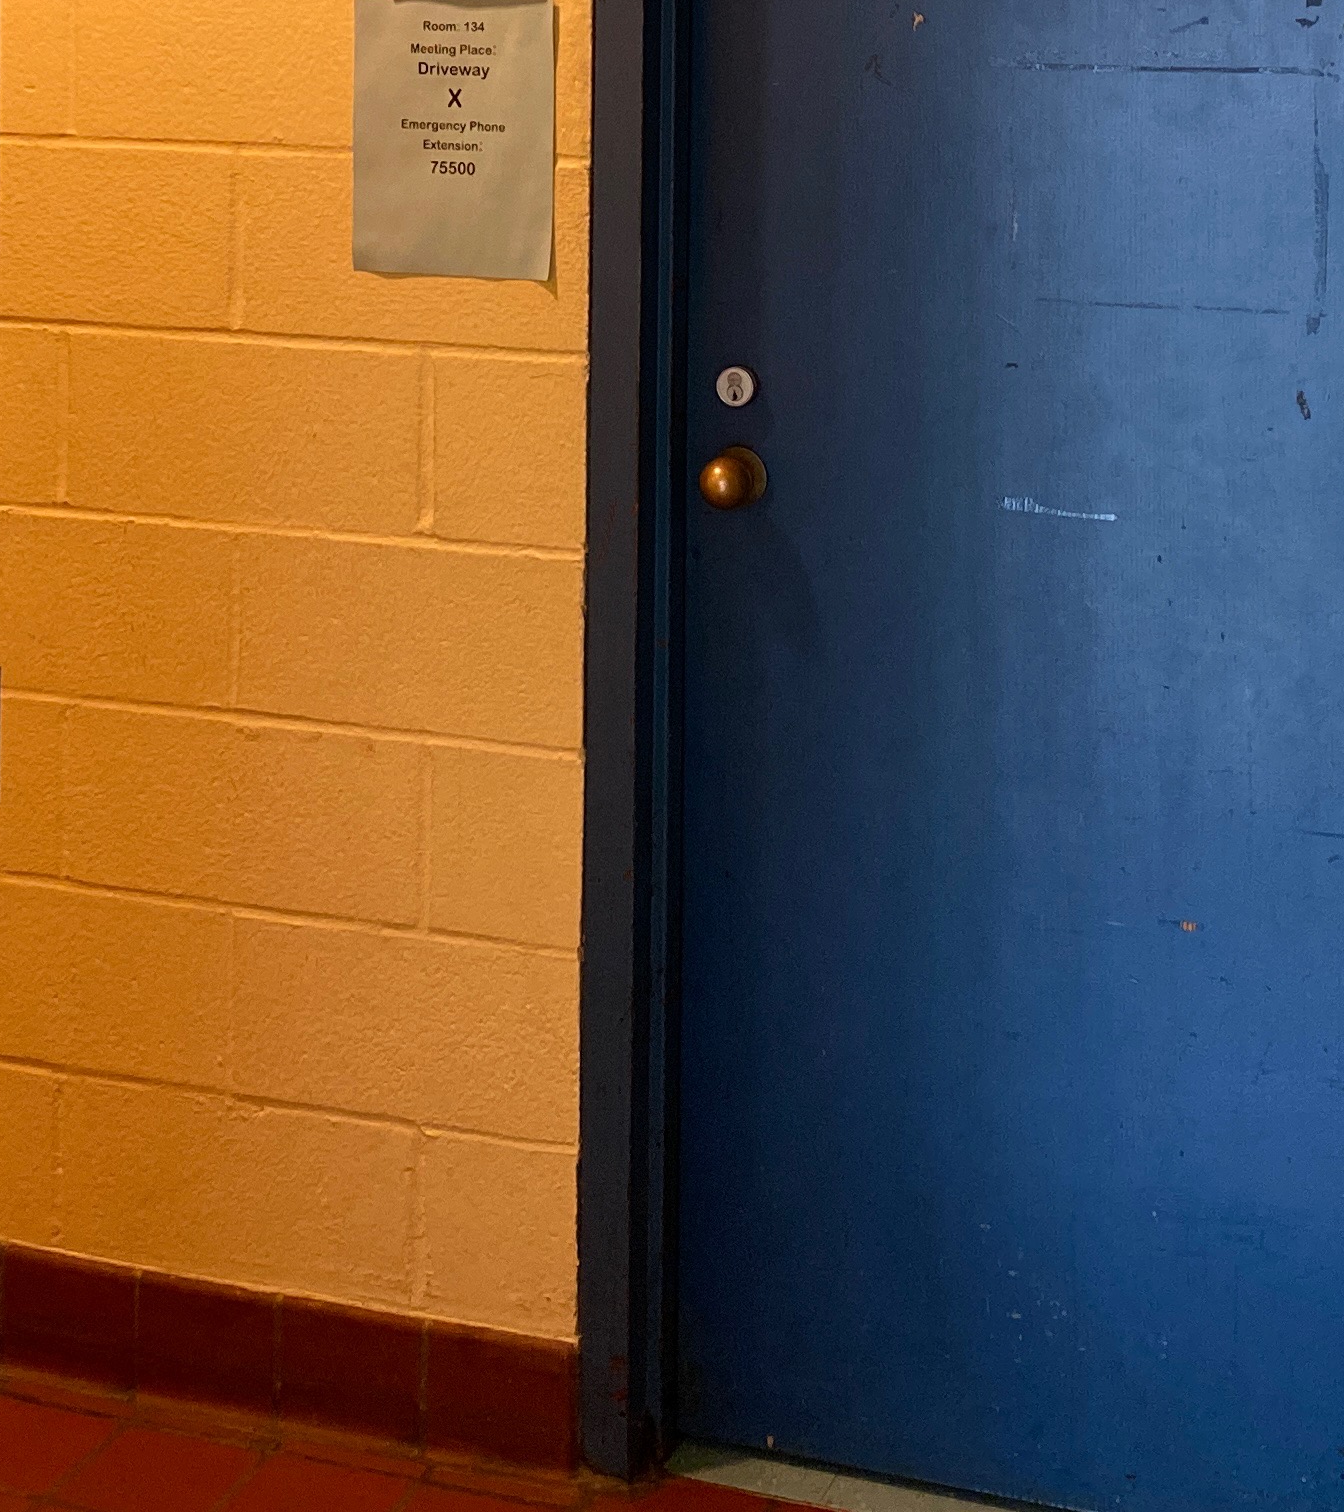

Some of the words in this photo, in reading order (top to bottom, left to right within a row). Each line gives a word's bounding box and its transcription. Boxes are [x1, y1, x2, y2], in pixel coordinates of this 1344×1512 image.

[422, 20, 460, 32] Room:
[463, 21, 485, 32] 134
[410, 43, 456, 57] Meeting
[459, 44, 497, 56] Place:
[418, 61, 490, 80] Driveway
[447, 88, 462, 108] X
[401, 118, 467, 134] Emergency
[469, 121, 506, 133] Phone
[423, 139, 484, 152] Extension:
[430, 160, 476, 176] 75500
